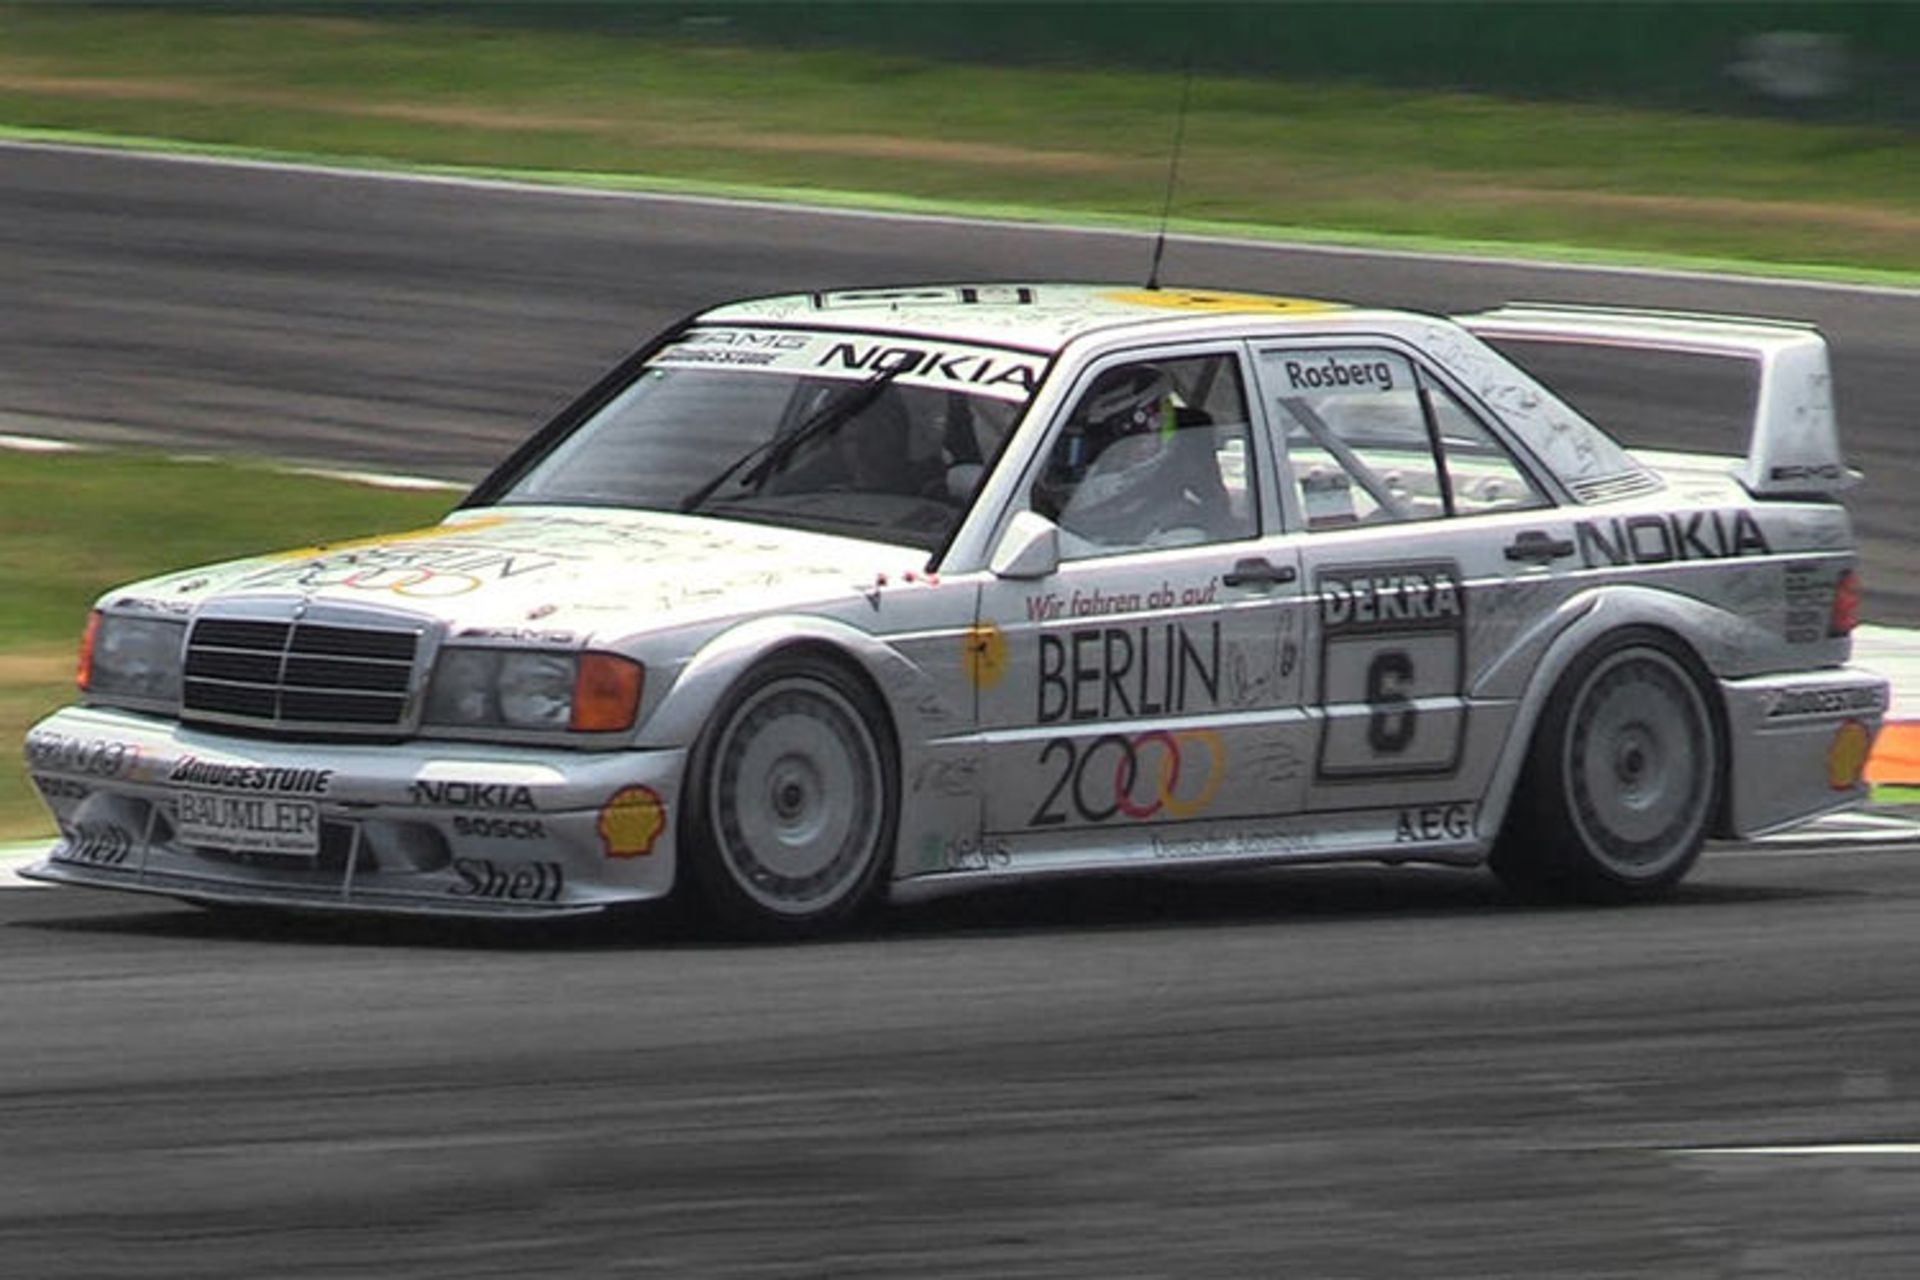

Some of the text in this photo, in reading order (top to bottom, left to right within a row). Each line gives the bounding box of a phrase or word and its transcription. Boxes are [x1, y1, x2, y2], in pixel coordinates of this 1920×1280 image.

[816, 341, 1040, 395] NOKIA
[1284, 356, 1394, 392] Rosberg
[1573, 508, 1773, 569] NOKIA
[1025, 576, 1218, 623] Wir fahren ab auf
[1319, 573, 1463, 625] DEKRA
[1037, 620, 1221, 723] BERLIN
[1367, 647, 1416, 756] 6
[169, 754, 335, 793] BRIDGESTONE
[412, 779, 538, 812] NOKIA
[1028, 728, 1227, 828] 2000
[1395, 805, 1471, 843] AEG
[446, 857, 564, 903] Shell
